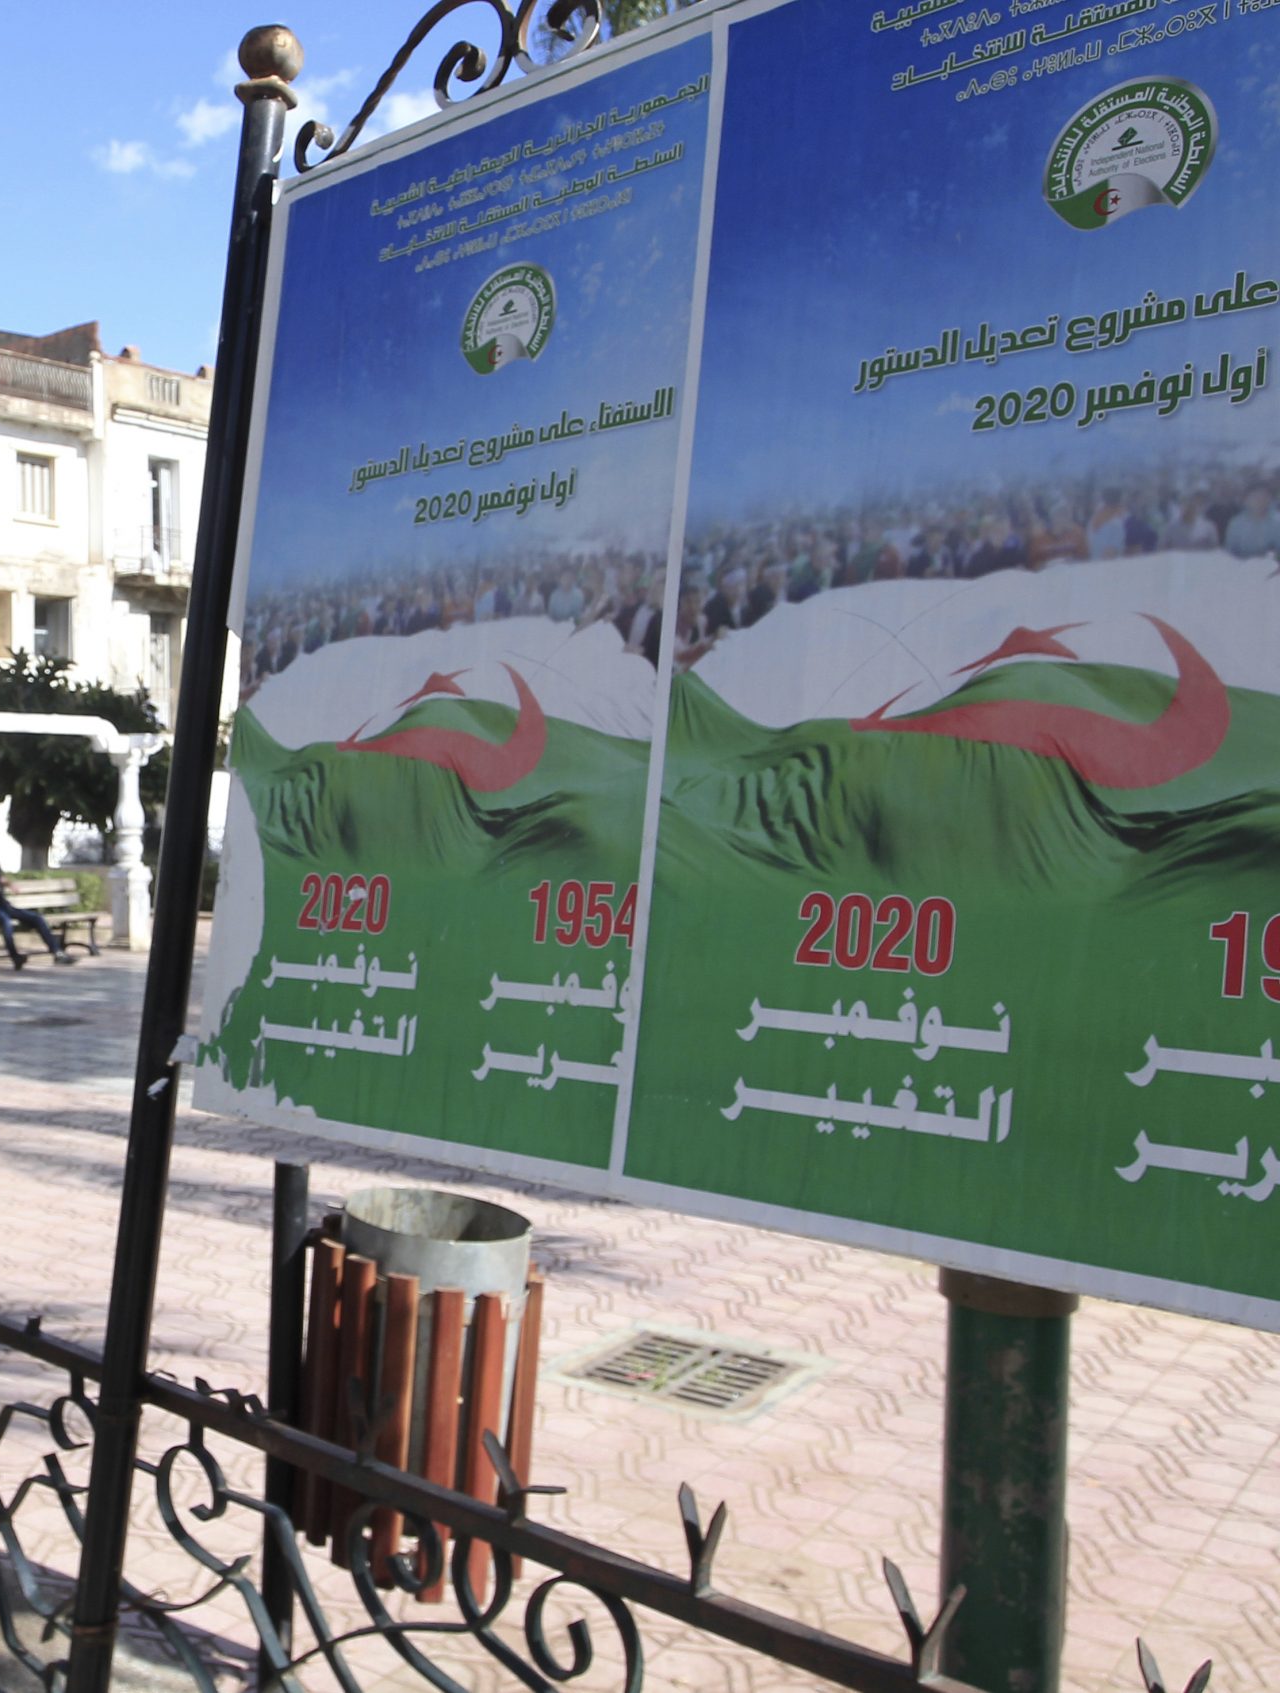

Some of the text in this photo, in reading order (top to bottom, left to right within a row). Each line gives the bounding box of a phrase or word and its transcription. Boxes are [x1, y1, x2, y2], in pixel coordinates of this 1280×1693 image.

[891, 29, 1026, 91] للانتخابات
[608, 73, 711, 126] الجمهورية
[523, 113, 606, 158] الجزائرية
[1090, 141, 1165, 167] Independent National
[427, 144, 521, 194] الديمقراطية
[607, 141, 683, 183] السلطة
[1088, 164, 1119, 178] Authority
[1133, 152, 1167, 167] Elections
[371, 181, 426, 216] الشعبية
[532, 170, 604, 207] الوطنية
[458, 196, 529, 235] المستقلة
[852, 270, 1280, 394] على مشروع تعديل الدستور
[971, 346, 1267, 432] أول نوفمبر 2020
[348, 386, 674, 492] الاستفتاء على مشروع تعديل الدستور
[413, 488, 472, 524] 2020
[472, 477, 537, 523] نوفمبر
[297, 872, 392, 935] 2020
[528, 879, 638, 950] 1954
[794, 890, 957, 977] 2020
[261, 943, 418, 998] نوفمبر
[251, 1008, 418, 1059] التغيير
[735, 986, 1013, 1062] نوفمبر
[720, 1074, 1014, 1144] التغيير
